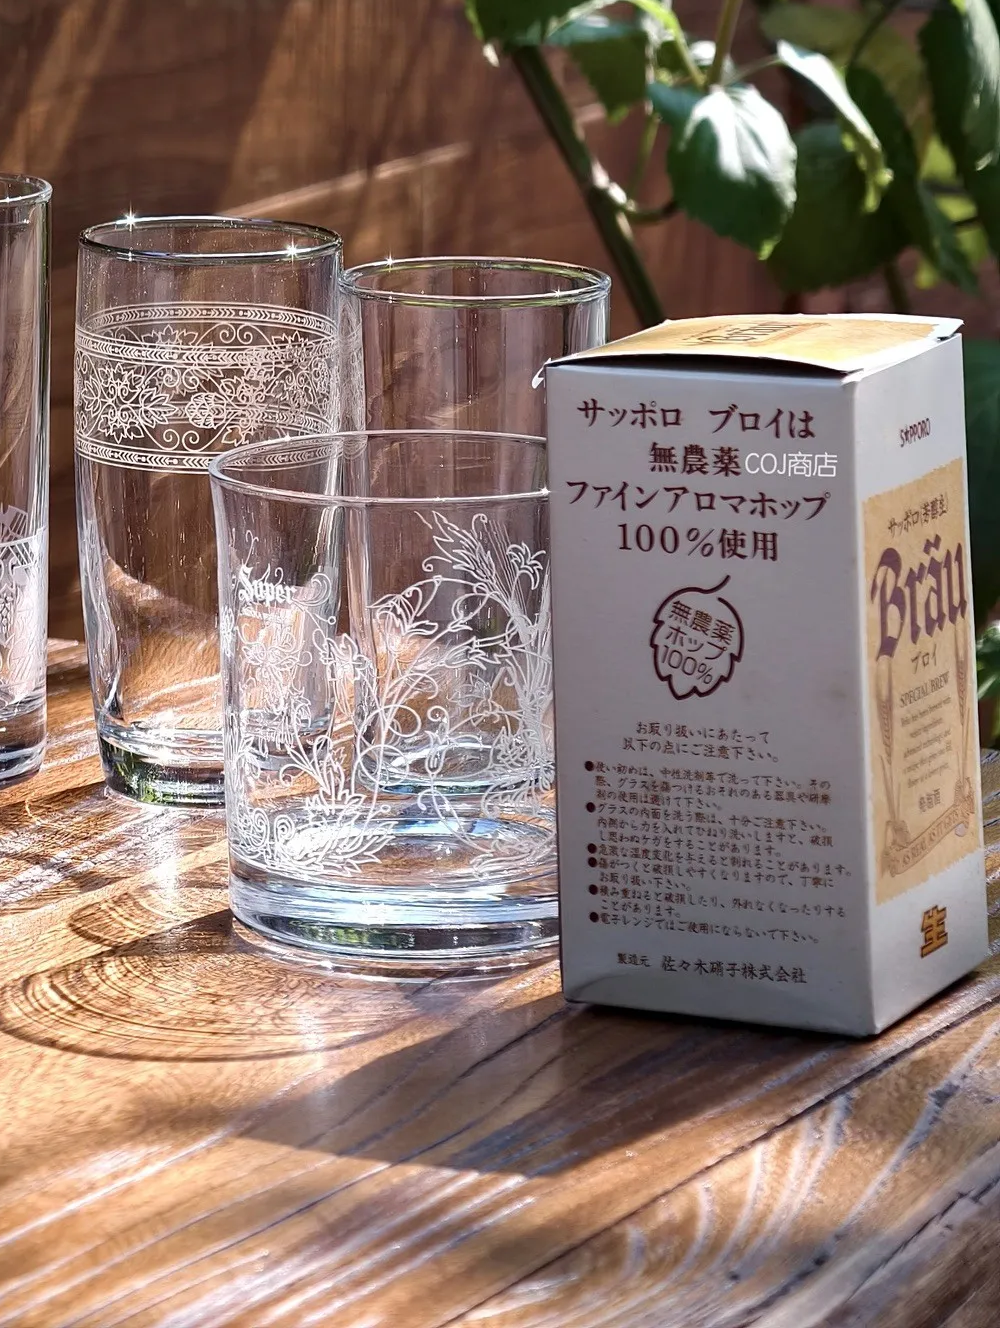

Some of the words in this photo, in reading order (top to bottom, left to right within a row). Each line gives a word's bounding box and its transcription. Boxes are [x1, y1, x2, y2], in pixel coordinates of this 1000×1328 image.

[577, 399, 683, 429] サッポロ
[708, 403, 816, 439] ブロイは
[649, 441, 742, 478] 無農薬
[566, 480, 832, 521] ファインアロマホップ
[617, 523, 780, 562] 100%使用
[870, 533, 968, 661] Bräu
[668, 600, 736, 646] 無農薬
[665, 626, 728, 660] ホップ
[911, 643, 938, 674] ブロイ
[661, 644, 713, 685] 100%
[900, 681, 930, 708] SPECIAL
[930, 670, 950, 693] BREW
[622, 737, 779, 763] 以下の点にご注意下さい。
[635, 722, 771, 745] お取り扱いにあたって
[920, 904, 949, 959] 生
[617, 952, 651, 968] 製造元
[661, 955, 808, 985] 佐々木硝子株式会社
